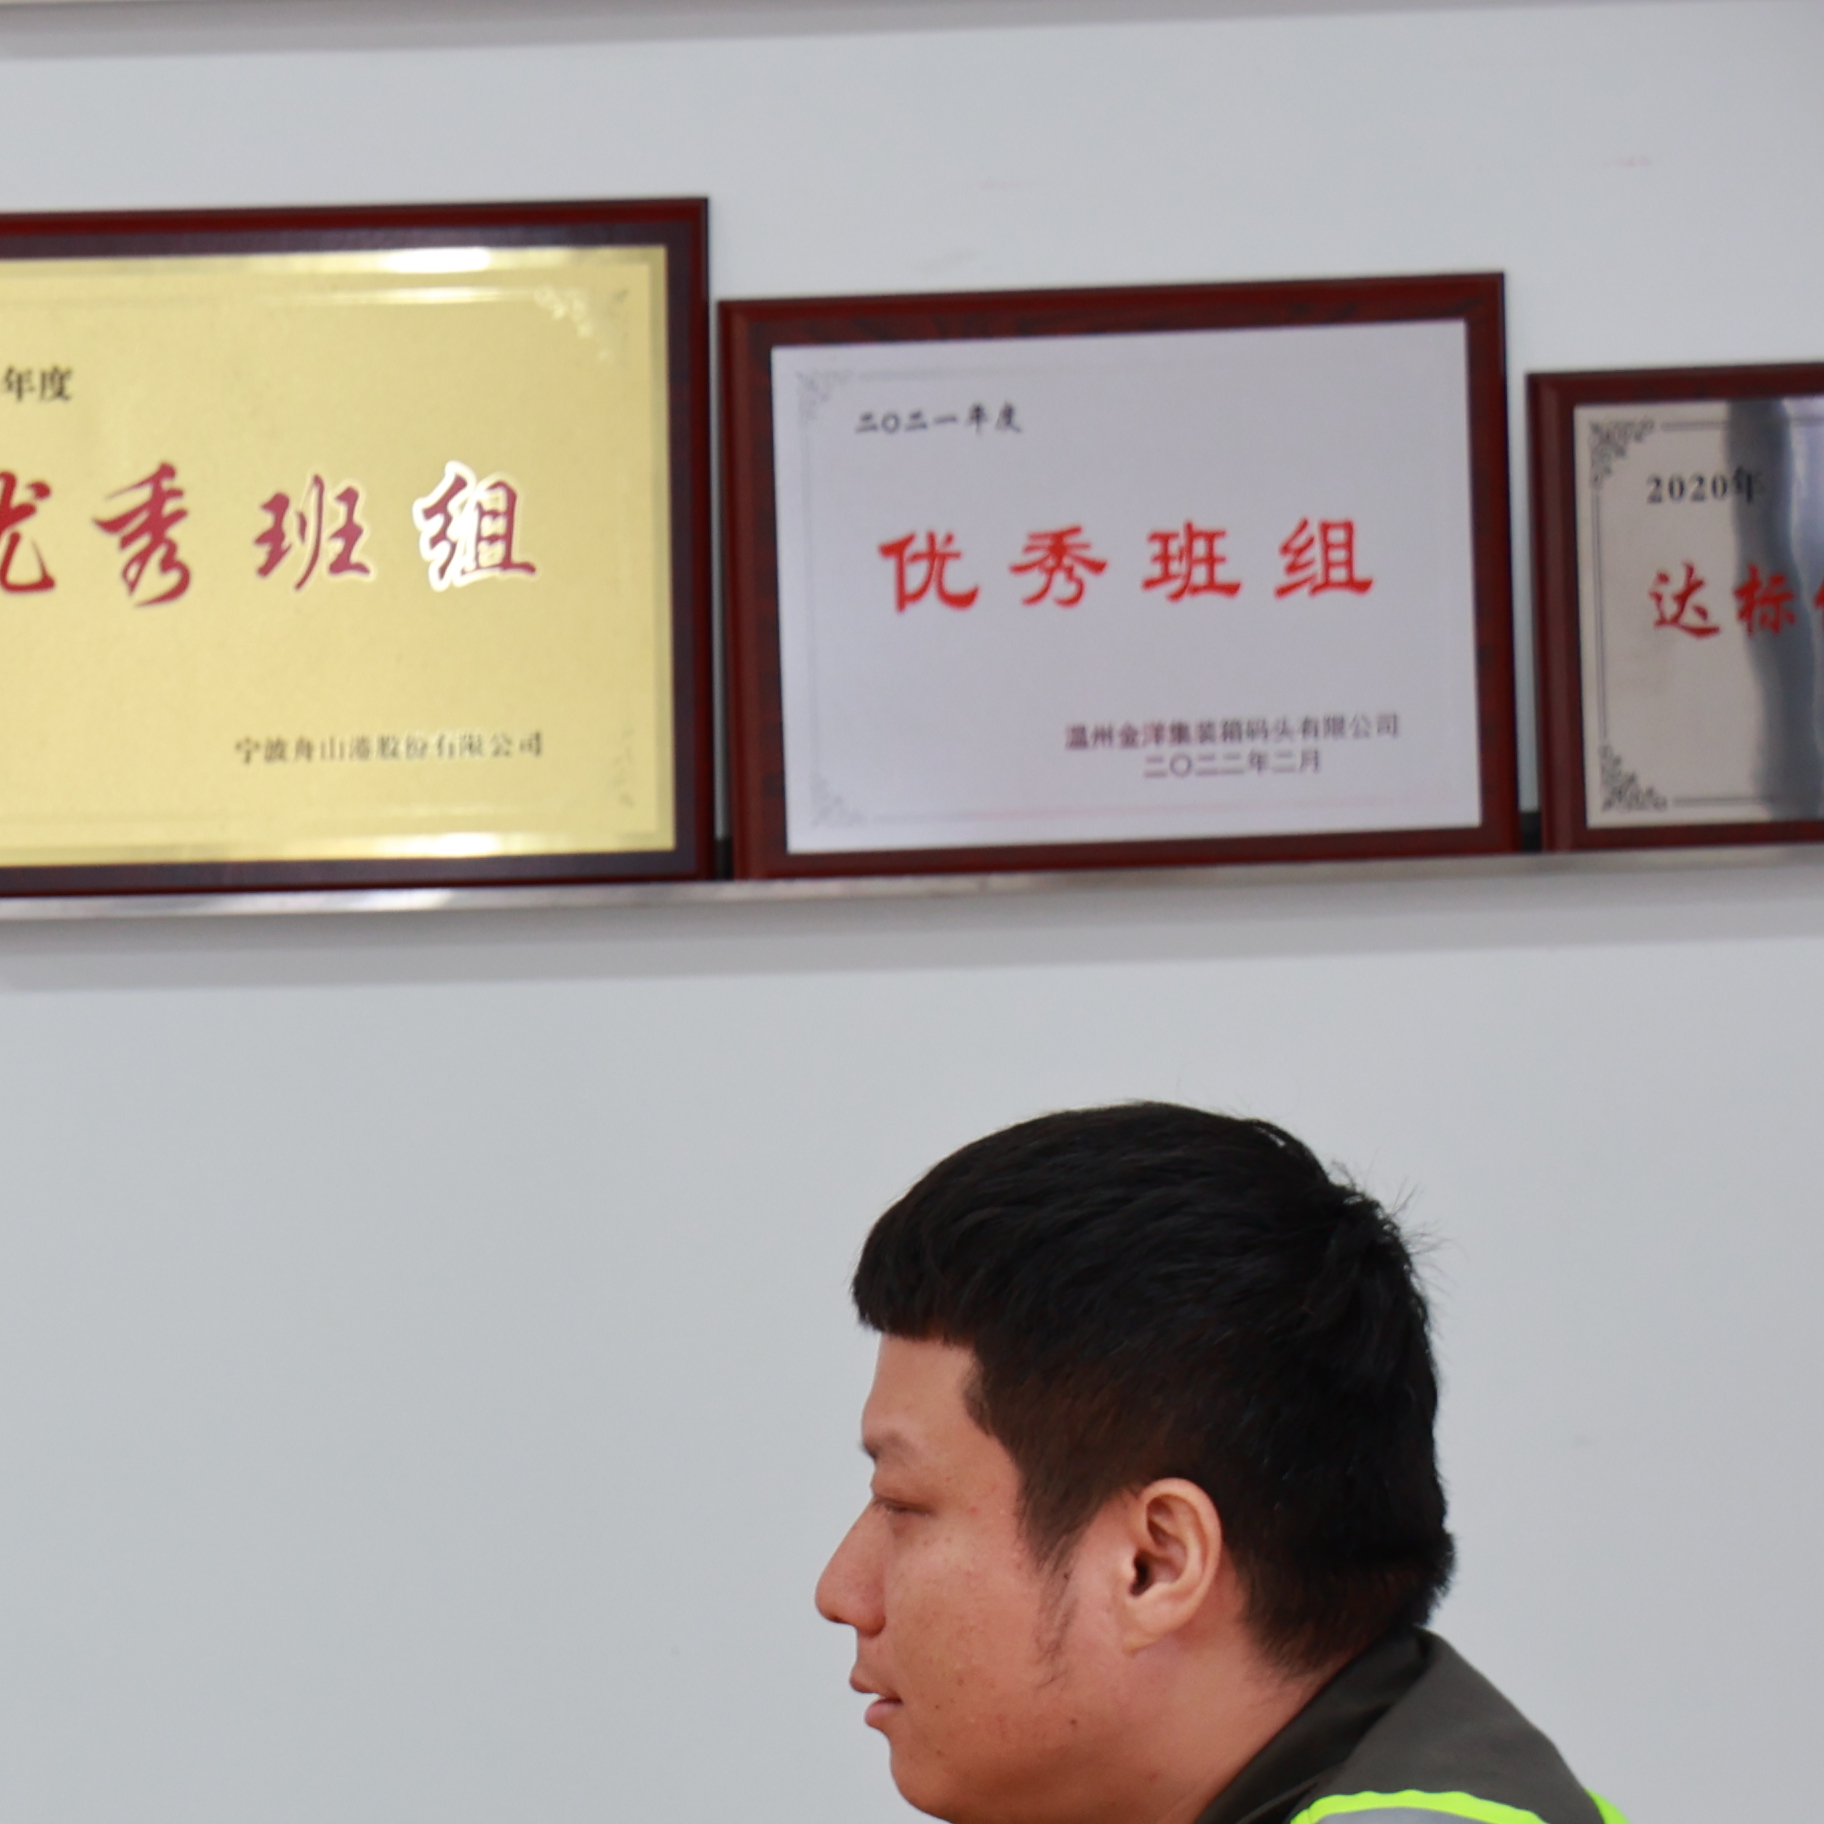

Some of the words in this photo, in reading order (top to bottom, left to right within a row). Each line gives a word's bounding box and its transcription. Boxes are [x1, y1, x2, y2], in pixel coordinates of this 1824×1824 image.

[878, 518, 1374, 614] 优秀班组
[1649, 557, 1824, 640] 达标
[233, 729, 545, 765] 宁波舟山港股份有限公司
[1065, 712, 1401, 751] 温州金洋集装箱码头有限公司
